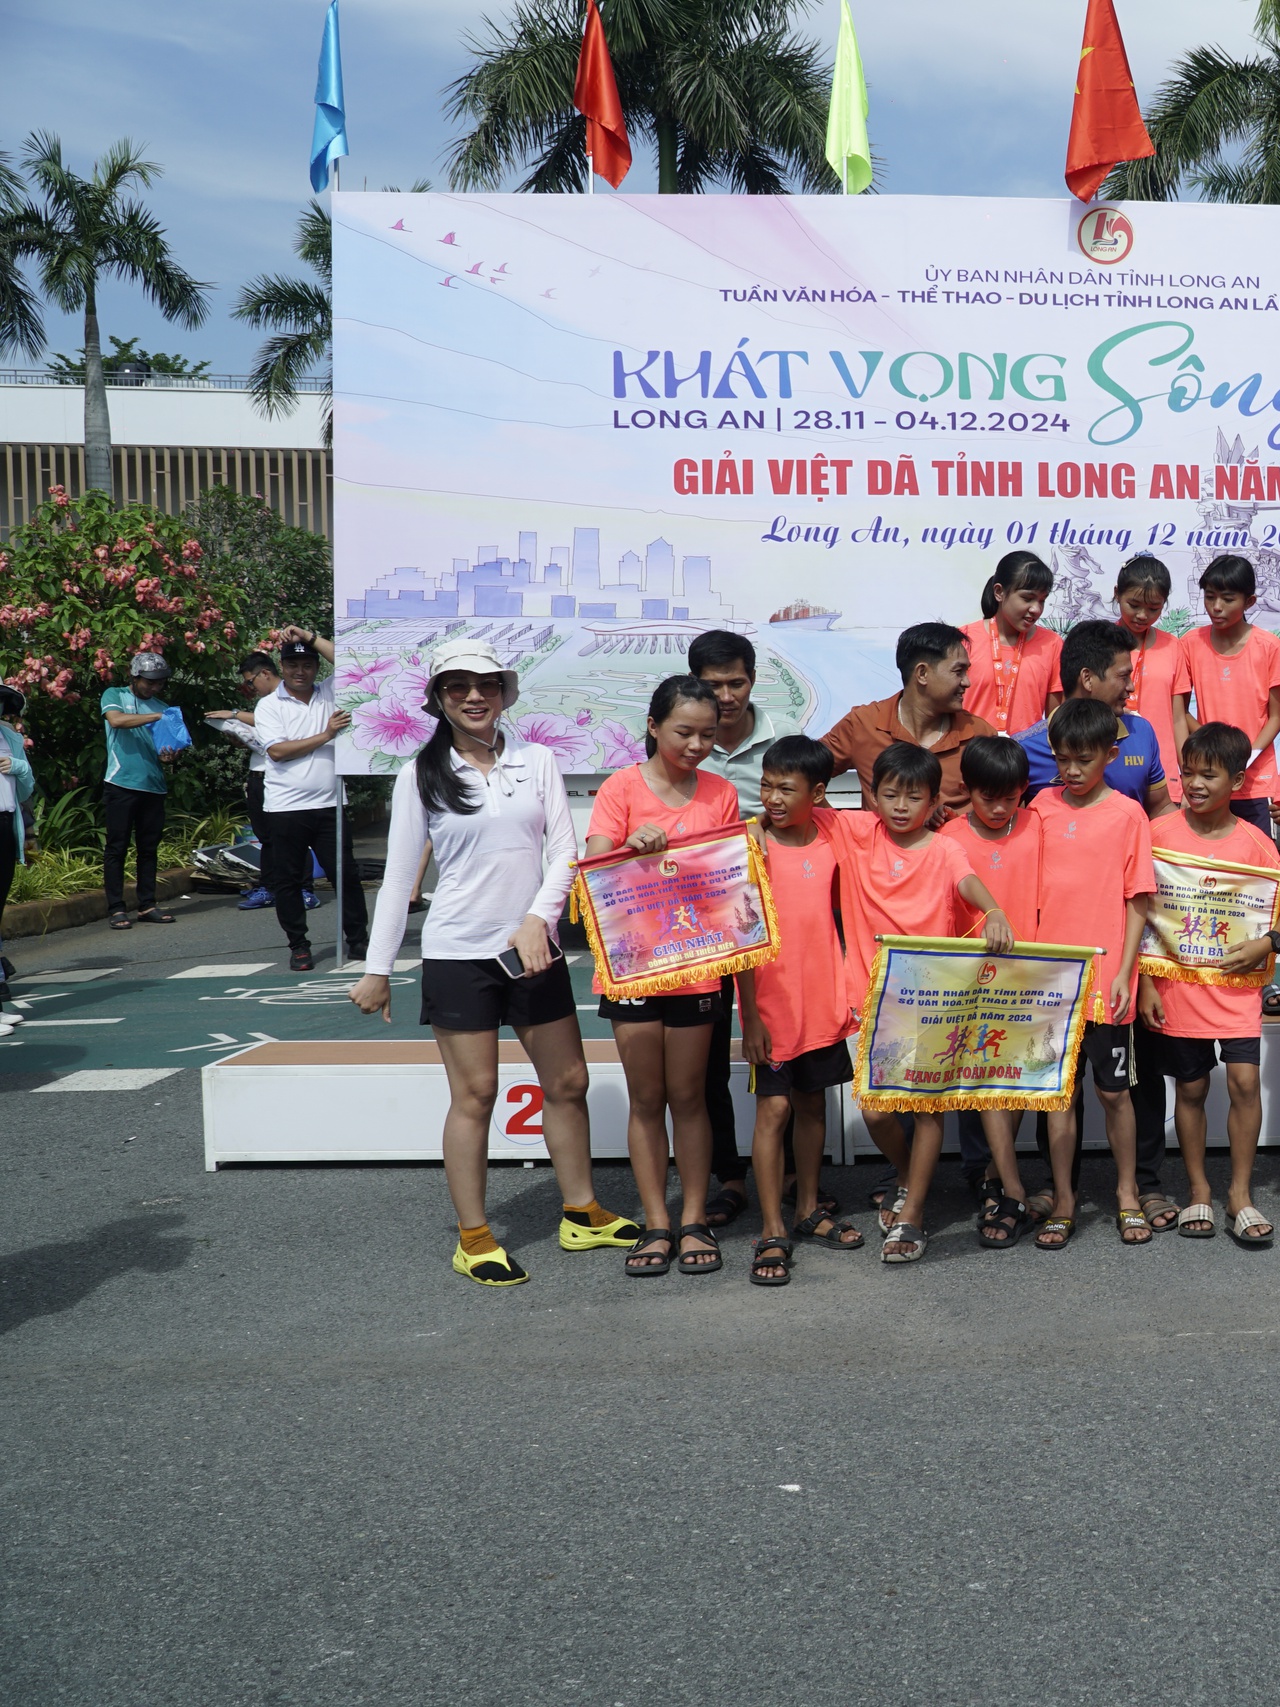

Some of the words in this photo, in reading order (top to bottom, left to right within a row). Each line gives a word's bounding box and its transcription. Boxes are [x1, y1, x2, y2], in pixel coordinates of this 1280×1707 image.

[925, 264, 952, 282] ỦY
[957, 269, 999, 283] BAN
[1004, 266, 1063, 285] NHÂN
[1069, 268, 1112, 286] DÂN
[1117, 268, 1164, 287] TỈNH
[1169, 274, 1226, 289] LONG
[1231, 276, 1260, 289] AN
[719, 284, 778, 303] TUẦN
[782, 285, 830, 302] VĂN
[831, 285, 877, 303] HÓA
[898, 285, 939, 304] THỂ
[946, 291, 1001, 305] THAO
[1019, 293, 1048, 306] DU
[1052, 293, 1100, 310] LỊCH
[1104, 290, 1152, 308] TỈNH
[1156, 296, 1214, 310] LONG
[1219, 298, 1249, 310] AN
[612, 336, 810, 399] KHÁT
[828, 350, 1067, 402] VỌNG
[612, 409, 708, 430] LONG
[717, 410, 766, 430] AN
[793, 410, 865, 430] 28.11
[895, 411, 1070, 432] 04.12.2024
[673, 449, 754, 495] GIẢI
[768, 452, 853, 502] VIỆT
[867, 454, 920, 496] DÃ
[932, 451, 1023, 498] TỈNH
[1038, 461, 1136, 500] LONG
[1149, 463, 1201, 501] AN
[760, 515, 841, 549] Long
[850, 515, 910, 548] An,
[921, 524, 995, 550] ngày
[1006, 519, 1038, 545] 01
[1048, 518, 1143, 552] tháng
[1147, 521, 1178, 546] 12
[1185, 525, 1252, 549] năm
[1124, 755, 1144, 767] HLV
[616, 887, 634, 897] BAN
[704, 868, 727, 878] LONG
[729, 864, 741, 873] AN
[676, 881, 698, 891] THAO
[709, 876, 722, 885] DU
[705, 888, 727, 899] 2024
[1228, 910, 1246, 918] 2024
[1208, 946, 1224, 957] BA
[918, 989, 939, 997] BAN
[943, 988, 970, 997] NHÂN
[972, 986, 990, 996] DÂN
[1048, 991, 1063, 999] AN
[918, 997, 938, 1007] VĂN
[982, 997, 1008, 1006] THAO
[1036, 998, 1061, 1008] LỊCH
[980, 1010, 1005, 1021] NĂM
[1007, 1014, 1032, 1023] 2024
[1112, 1047, 1126, 1077] 2
[506, 1084, 545, 1135] 2
